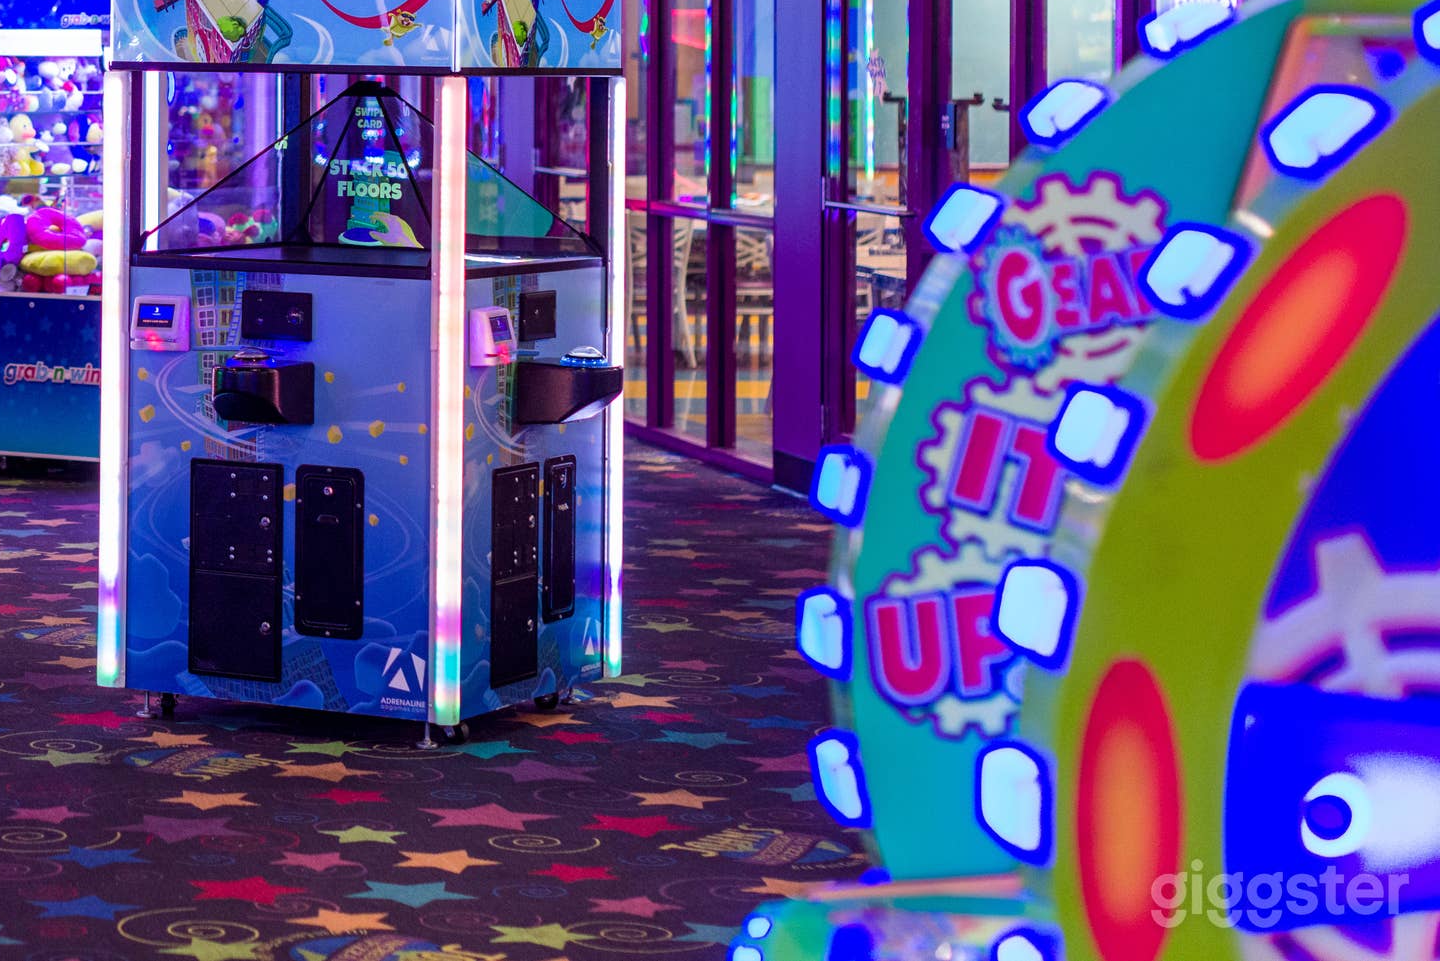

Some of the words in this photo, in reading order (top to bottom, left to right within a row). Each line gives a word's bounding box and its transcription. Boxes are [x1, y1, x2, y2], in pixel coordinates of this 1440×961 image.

[357, 119, 382, 128] CARD
[330, 160, 383, 177] STACK
[387, 161, 408, 179] 50
[337, 181, 402, 200] FLOORS
[4, 361, 48, 385] grab
[70, 363, 101, 384] win
[954, 408, 1062, 525] IT
[873, 592, 1013, 703] UP
[381, 697, 426, 708] ADRENALINE
